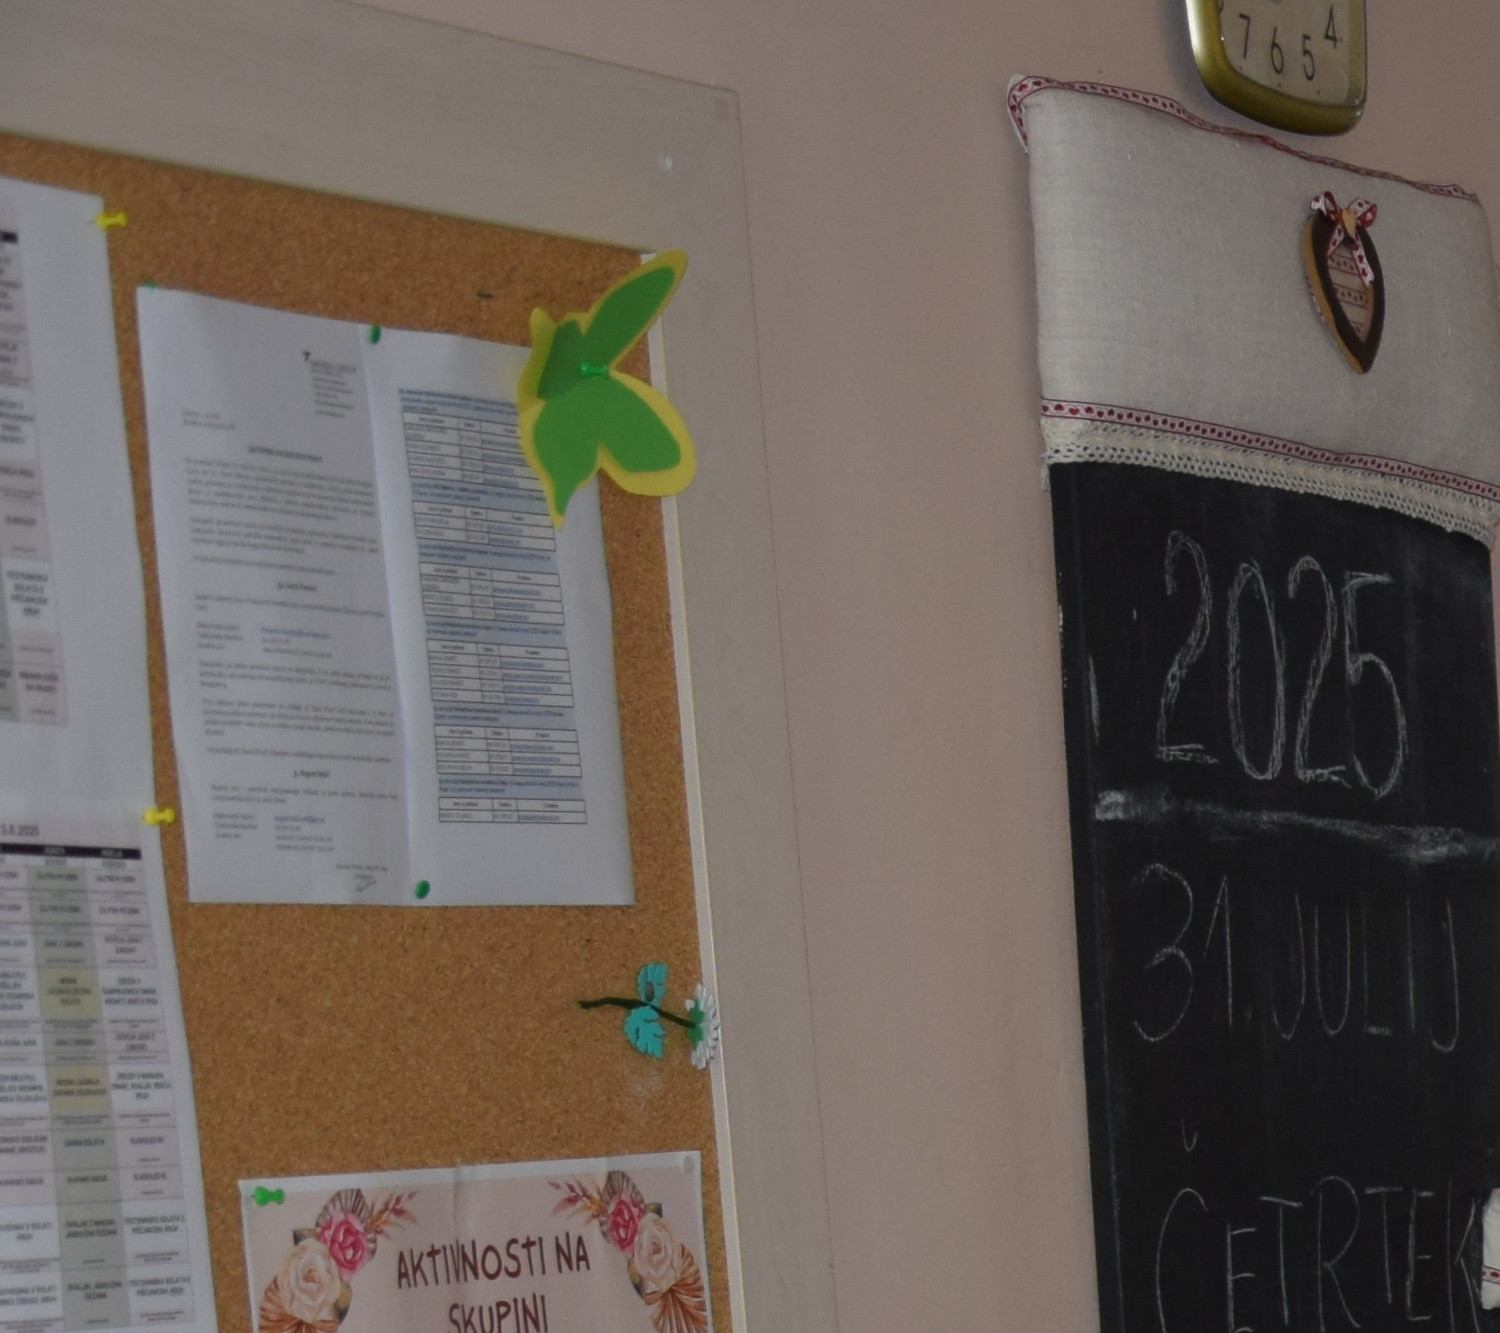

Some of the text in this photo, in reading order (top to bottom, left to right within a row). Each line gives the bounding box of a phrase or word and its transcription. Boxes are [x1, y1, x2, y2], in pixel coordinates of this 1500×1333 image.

[1239, 13, 1316, 82] 7 6 5
[1323, 5, 1338, 50] 4
[1156, 529, 1408, 800] 2025
[397, 1230, 591, 1290] AKTIVNOSTI NA
